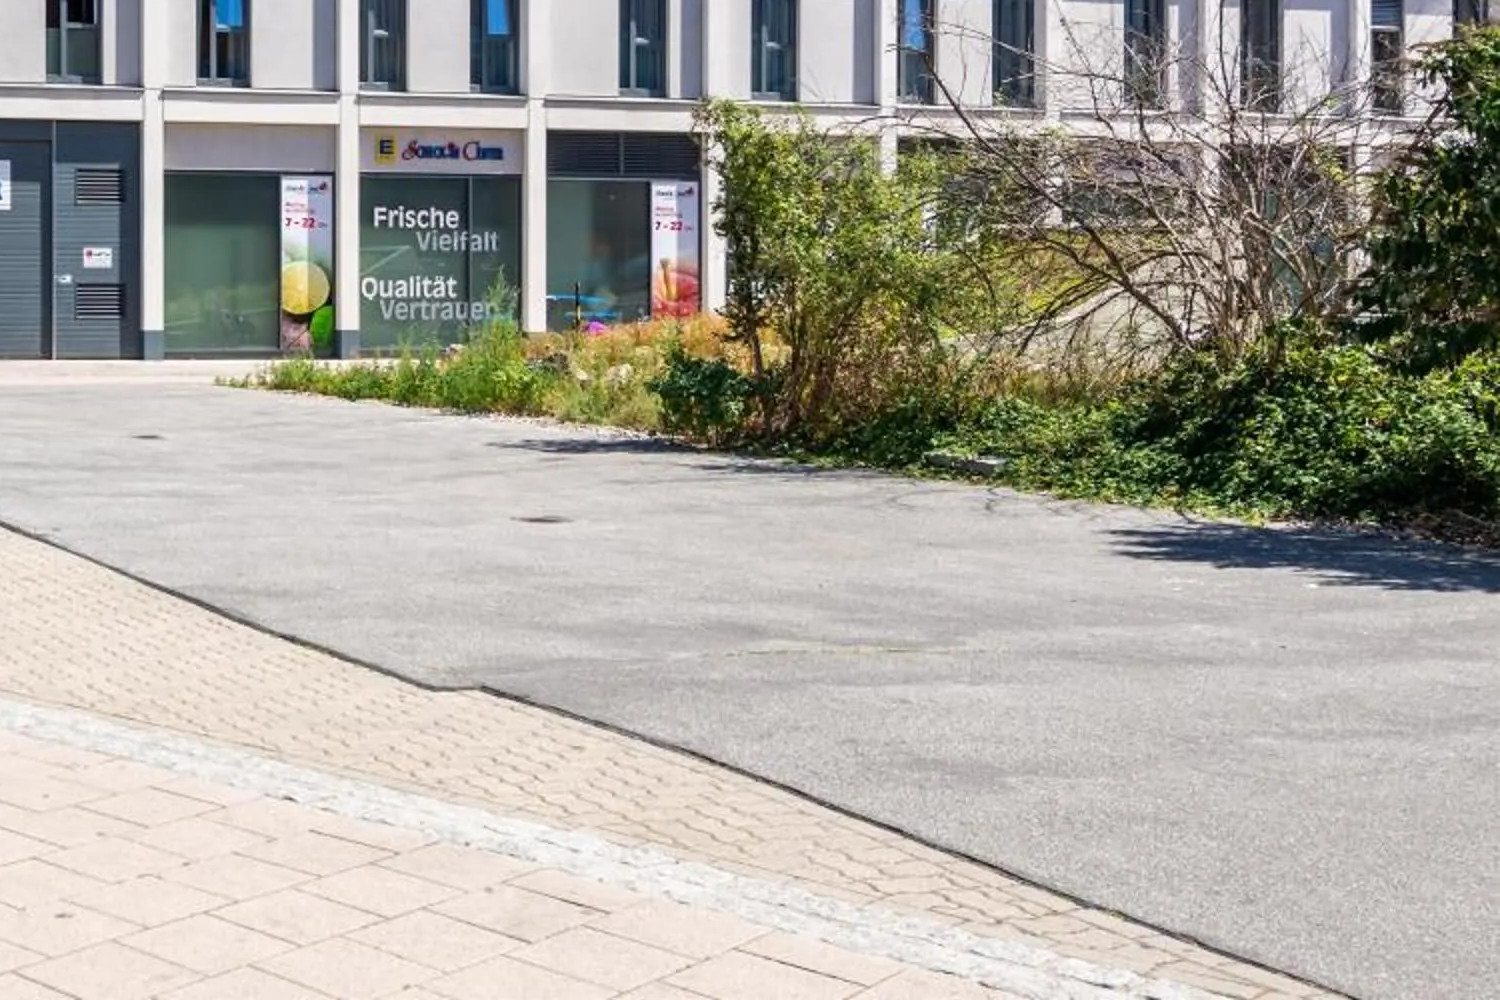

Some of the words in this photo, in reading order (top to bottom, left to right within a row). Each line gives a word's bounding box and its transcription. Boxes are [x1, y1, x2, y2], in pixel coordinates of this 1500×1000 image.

[373, 205, 460, 229] Frische
[416, 230, 499, 252] Vielfalt
[361, 275, 458, 300] Qualität
